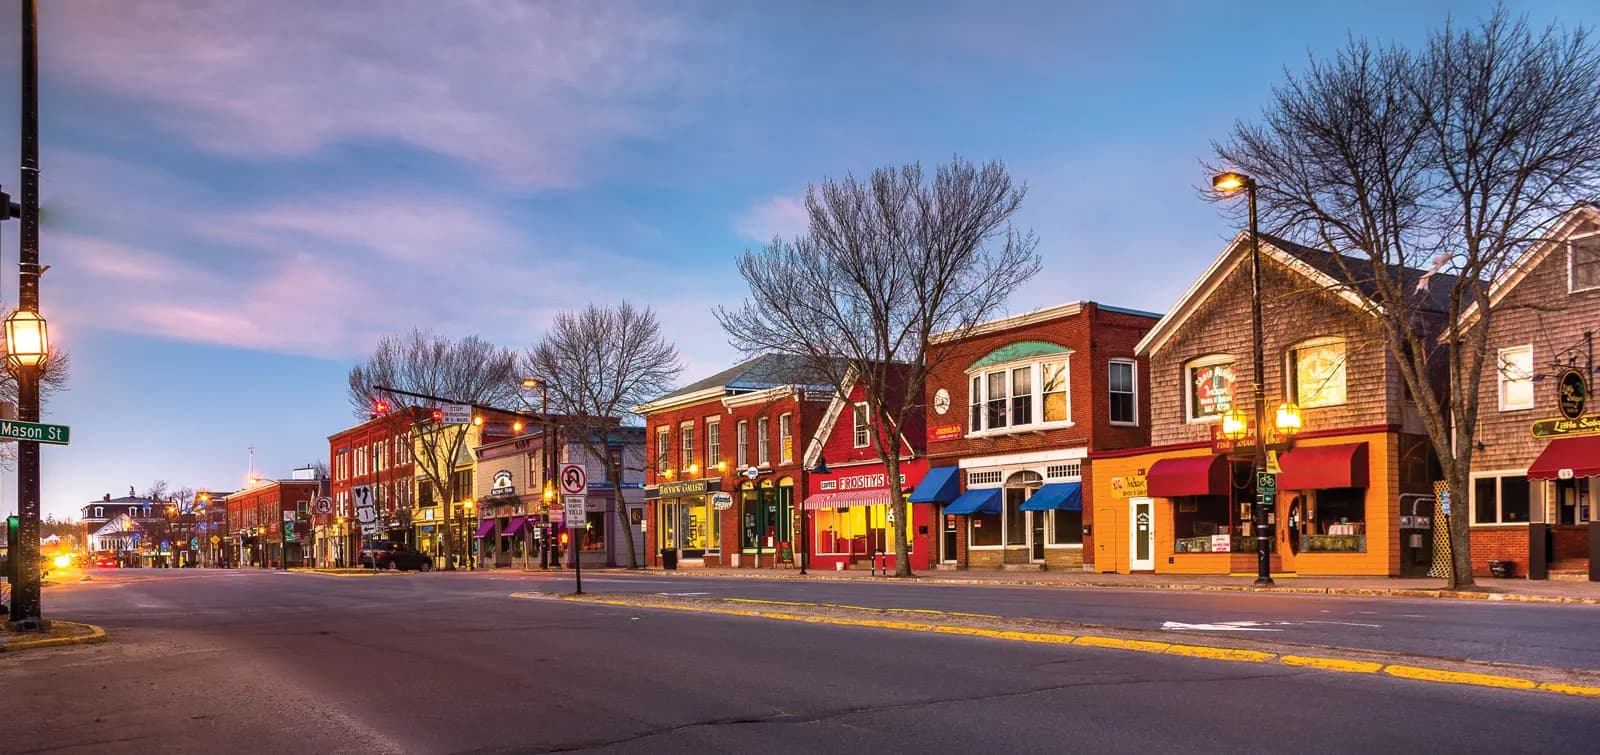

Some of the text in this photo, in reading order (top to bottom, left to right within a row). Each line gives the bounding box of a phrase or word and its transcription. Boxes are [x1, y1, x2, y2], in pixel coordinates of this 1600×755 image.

[1, 422, 62, 440] Mason St
[1554, 420, 1577, 432] Little
[682, 482, 705, 493] GALLERY
[839, 475, 884, 490] FROSTYS
[364, 510, 369, 520] 1
